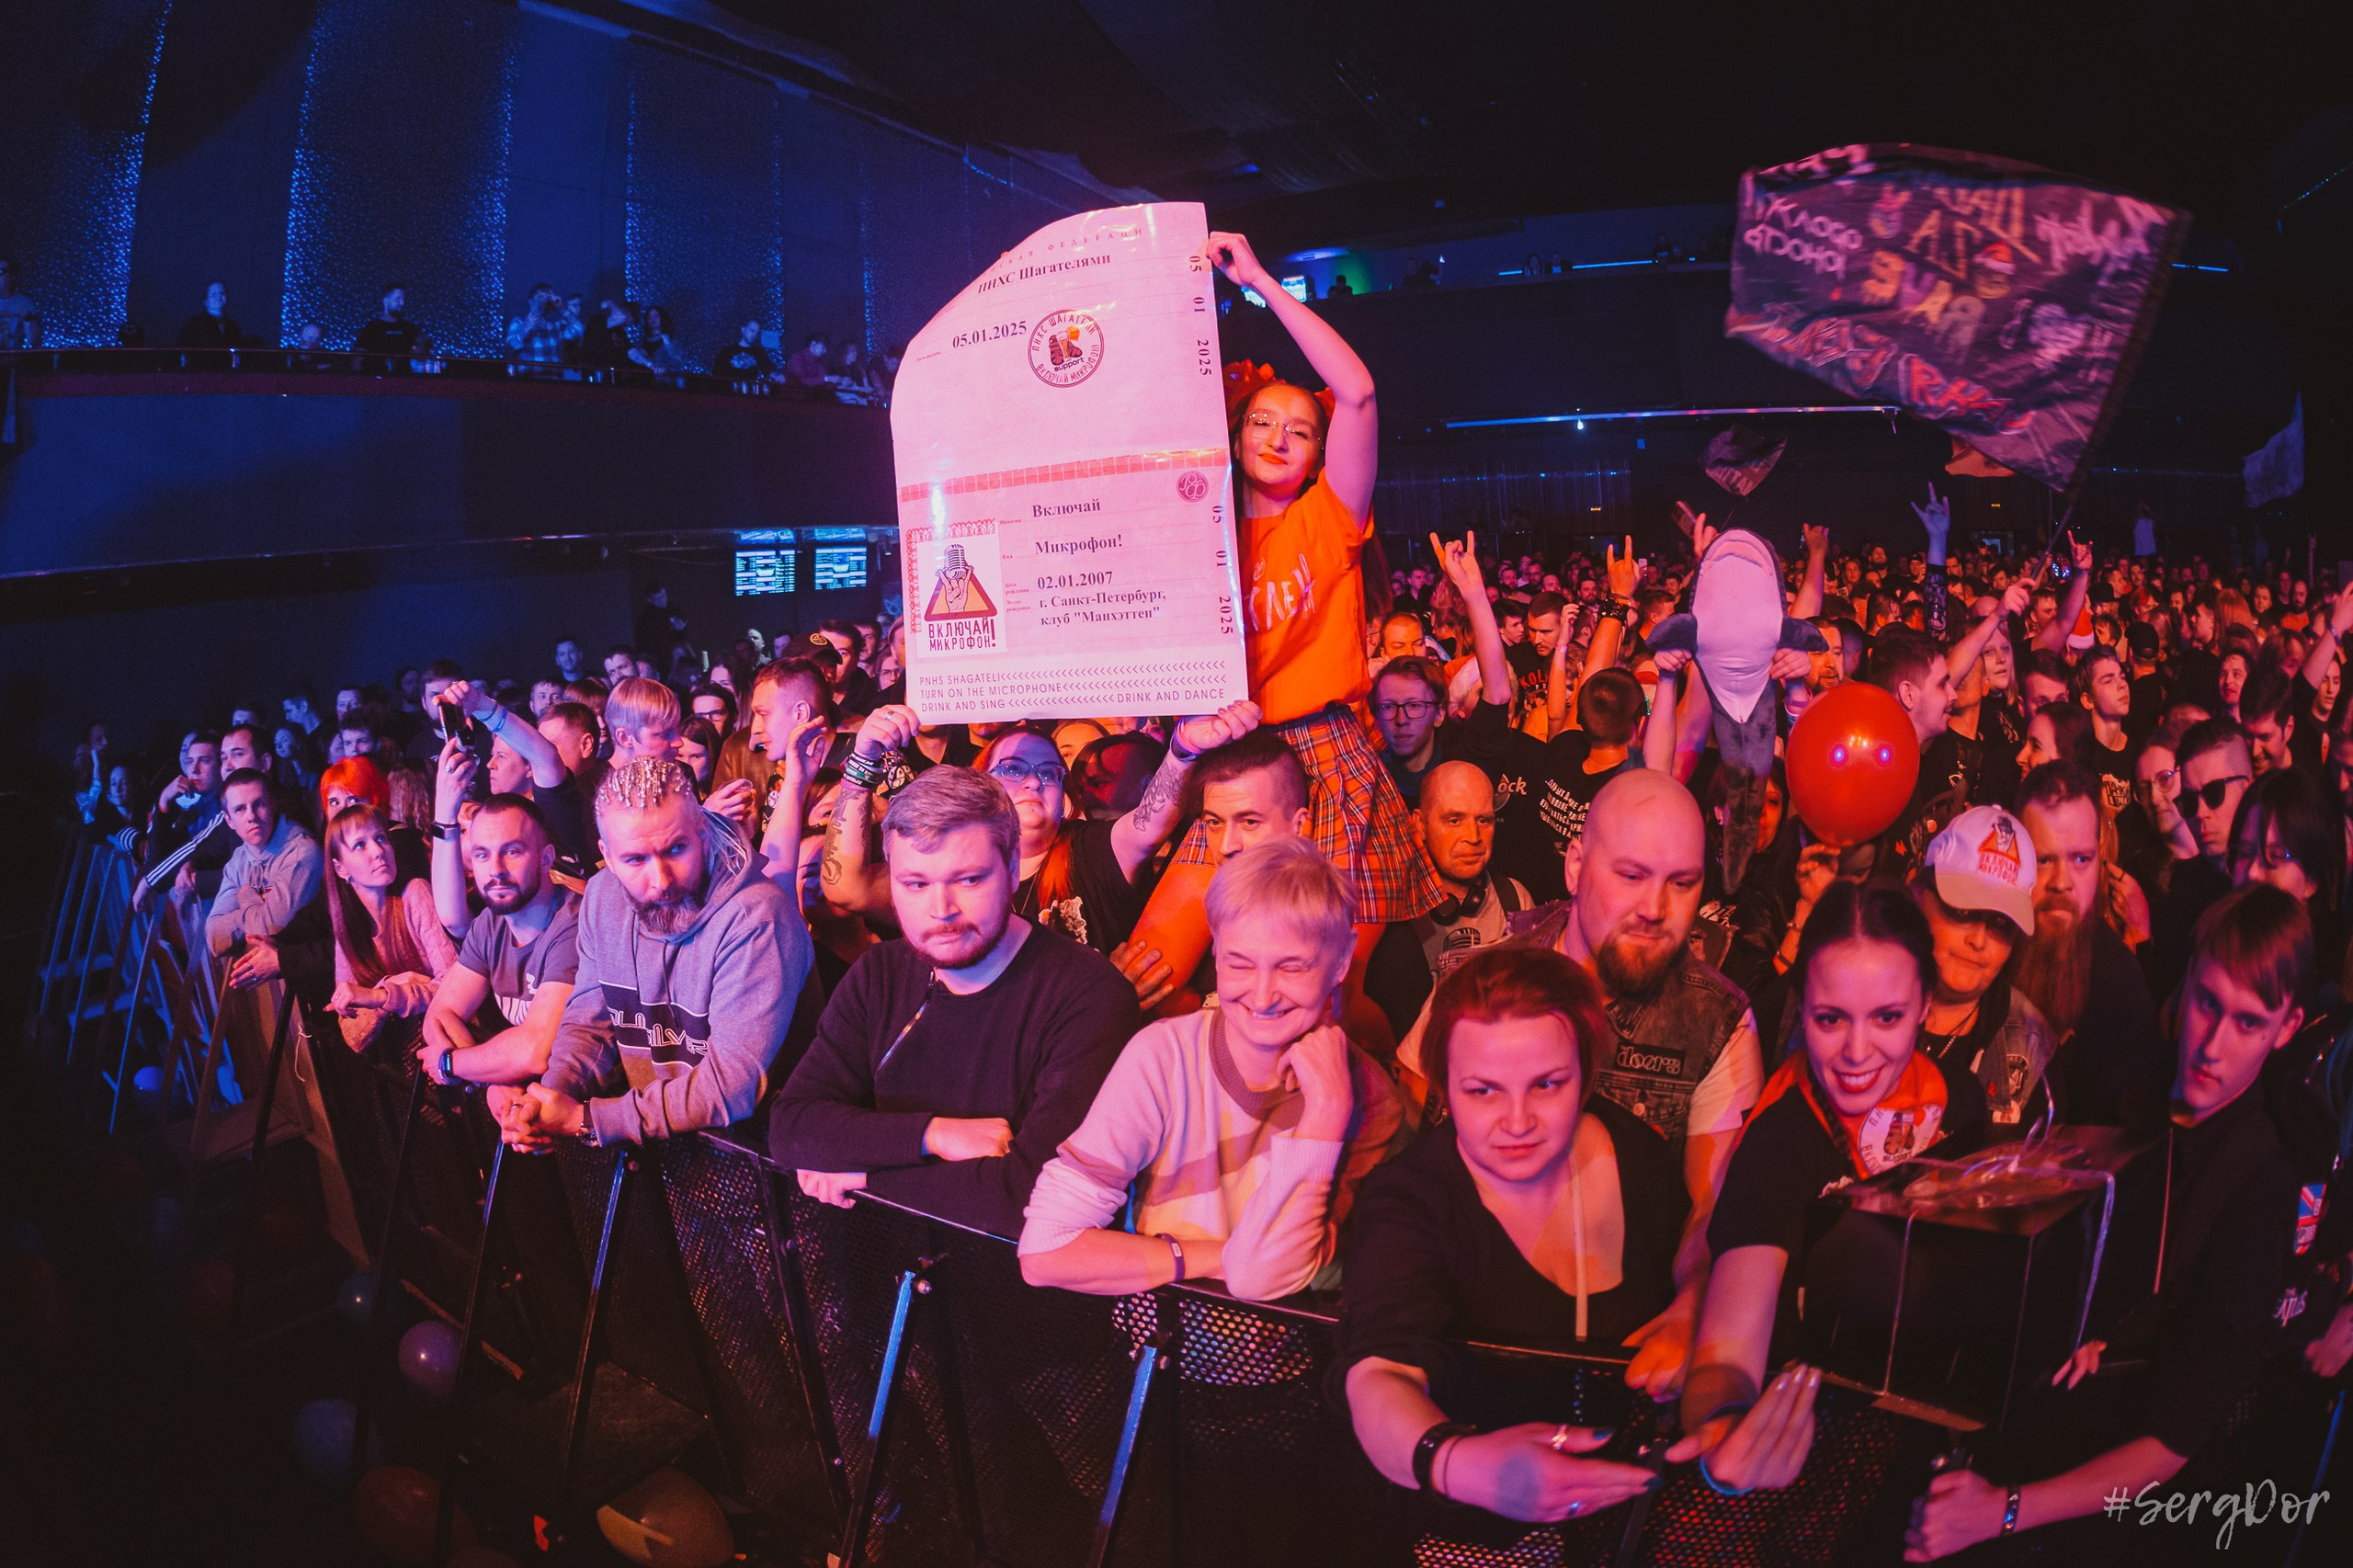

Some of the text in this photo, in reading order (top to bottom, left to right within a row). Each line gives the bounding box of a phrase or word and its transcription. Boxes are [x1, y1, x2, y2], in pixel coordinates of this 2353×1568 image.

[977, 255, 1111, 294] ПНХС Шагателями
[1189, 256, 1212, 376] 05 01 2025
[952, 320, 1028, 349] 05.01.2025
[1032, 325, 1048, 352] ПНХС
[1053, 358, 1085, 372] support
[1032, 498, 1101, 517] Включай
[1035, 534, 1122, 555] Микрофон!
[1212, 506, 1233, 634] 05 01 2025
[1037, 571, 1113, 590] 02.01.2007
[1040, 589, 1166, 608] г. Санкт-Петербург,
[1040, 607, 1161, 627] клуб "Манхэттен"
[928, 617, 990, 639] ВКЛЮЧАЙ
[919, 676, 944, 686] PNHS
[920, 688, 944, 699] TURN
[948, 687, 963, 699] ON
[967, 686, 984, 697] THE
[1117, 687, 1224, 704] DRINK AND DANCE
[921, 699, 1006, 712] DRINK AND SING
[1497, 777, 1527, 796] ock
[1617, 1046, 1680, 1074] doors
